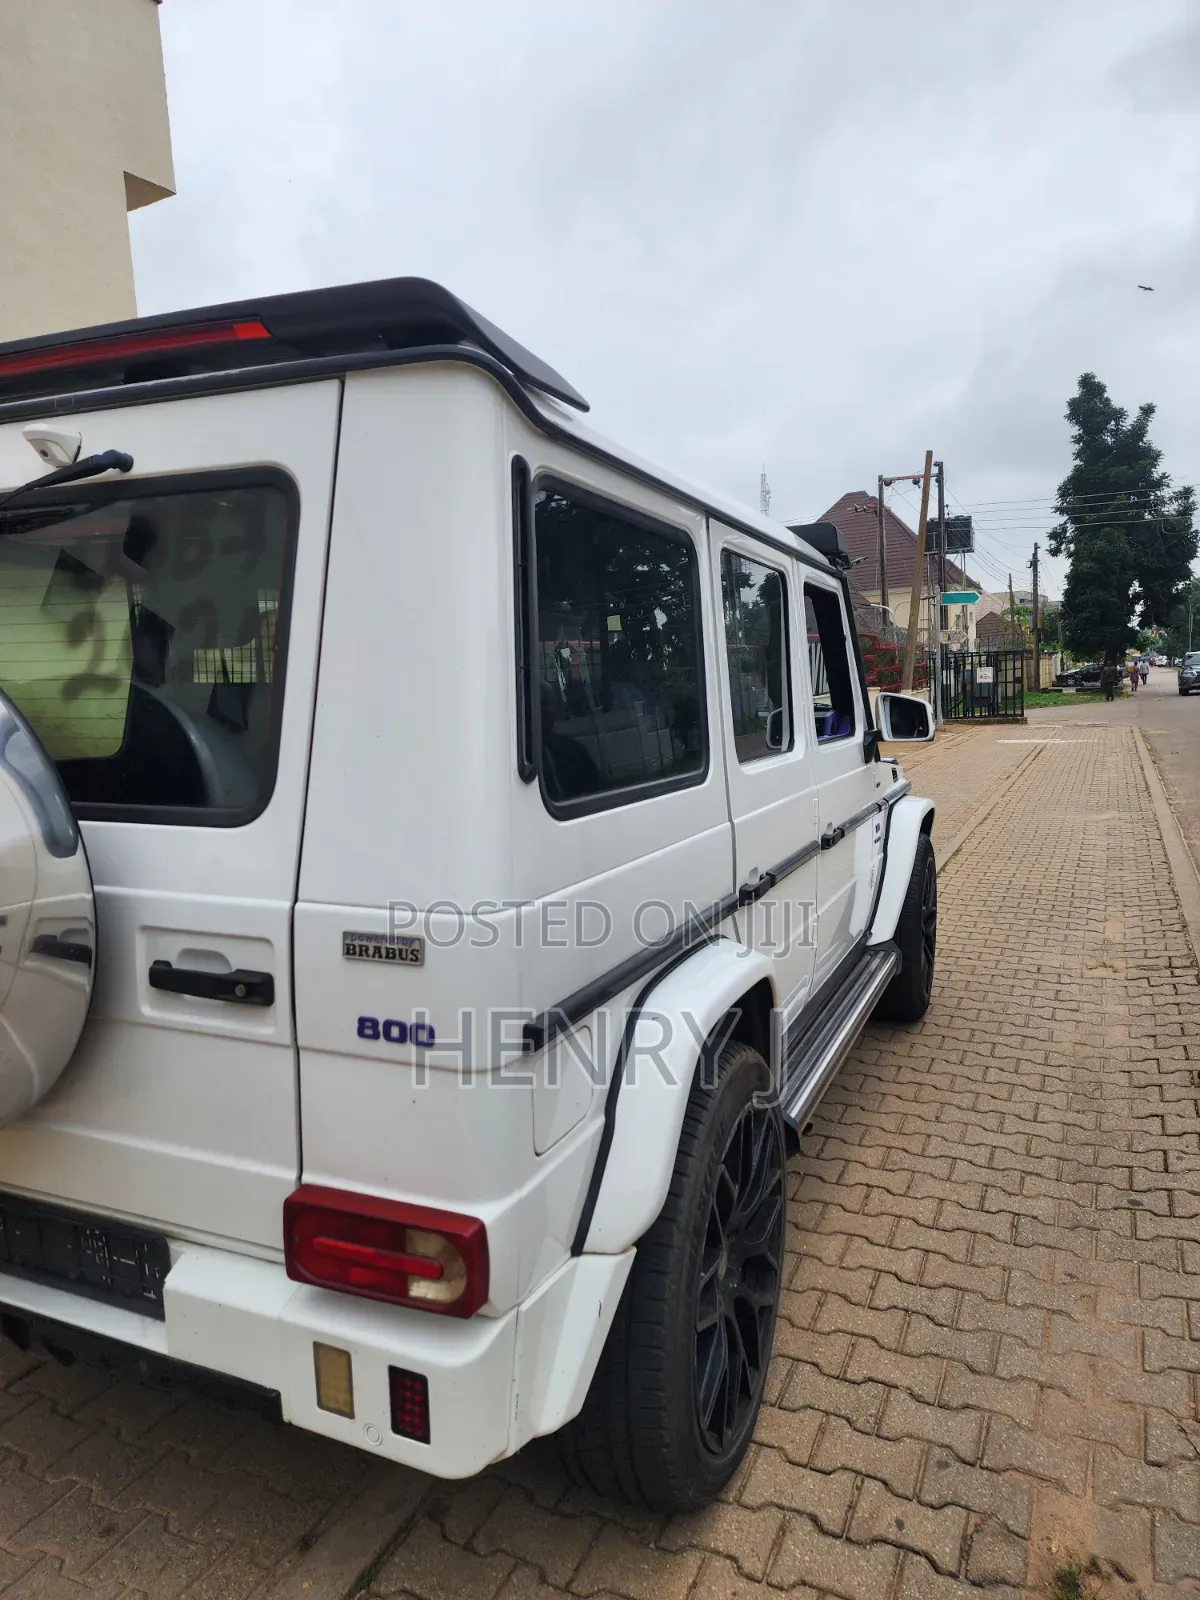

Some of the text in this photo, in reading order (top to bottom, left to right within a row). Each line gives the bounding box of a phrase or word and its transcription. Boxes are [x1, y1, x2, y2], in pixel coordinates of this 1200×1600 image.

[400, 936, 414, 947] by
[345, 943, 420, 962] BRABUS
[357, 1016, 436, 1048] 800
